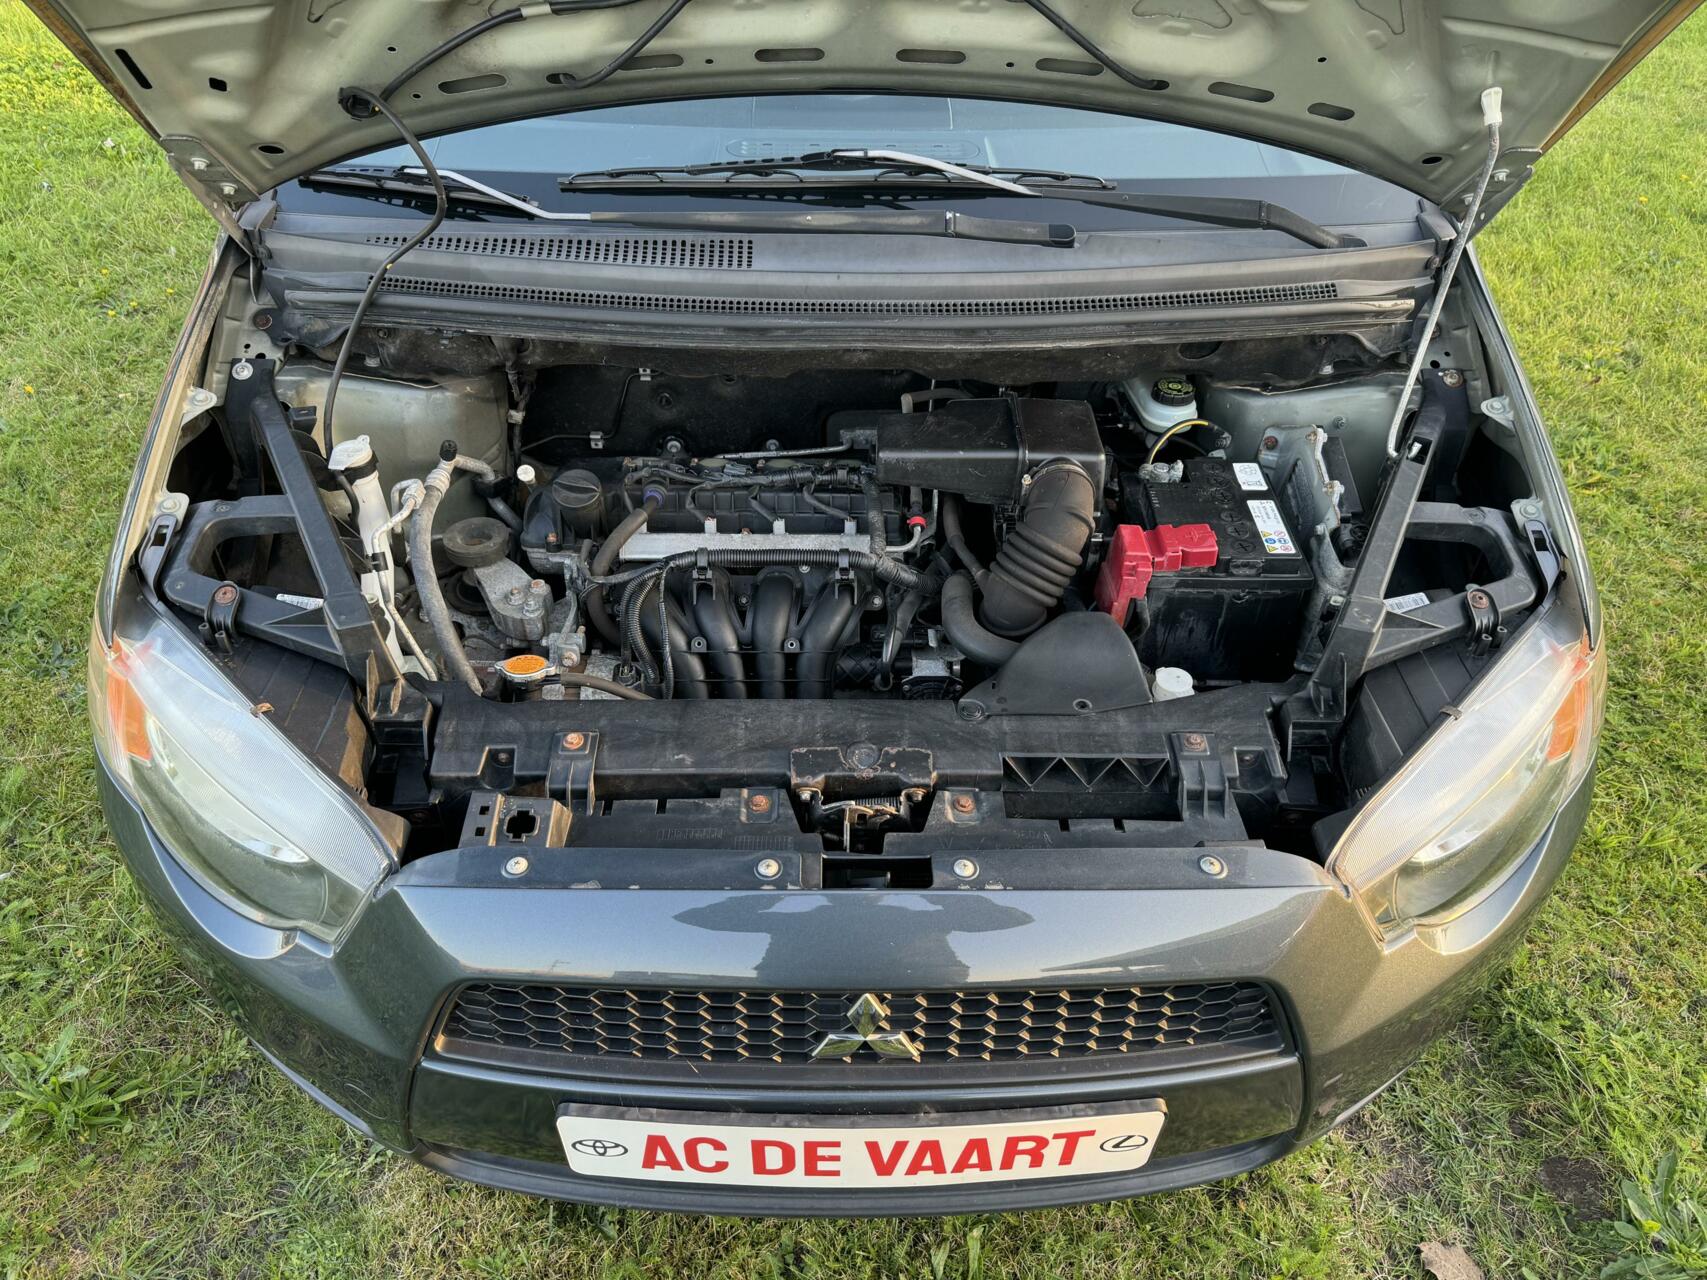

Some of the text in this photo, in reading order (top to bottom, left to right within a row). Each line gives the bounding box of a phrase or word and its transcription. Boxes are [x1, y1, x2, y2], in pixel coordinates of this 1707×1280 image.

[641, 1129, 1097, 1177] AC DE VAART
